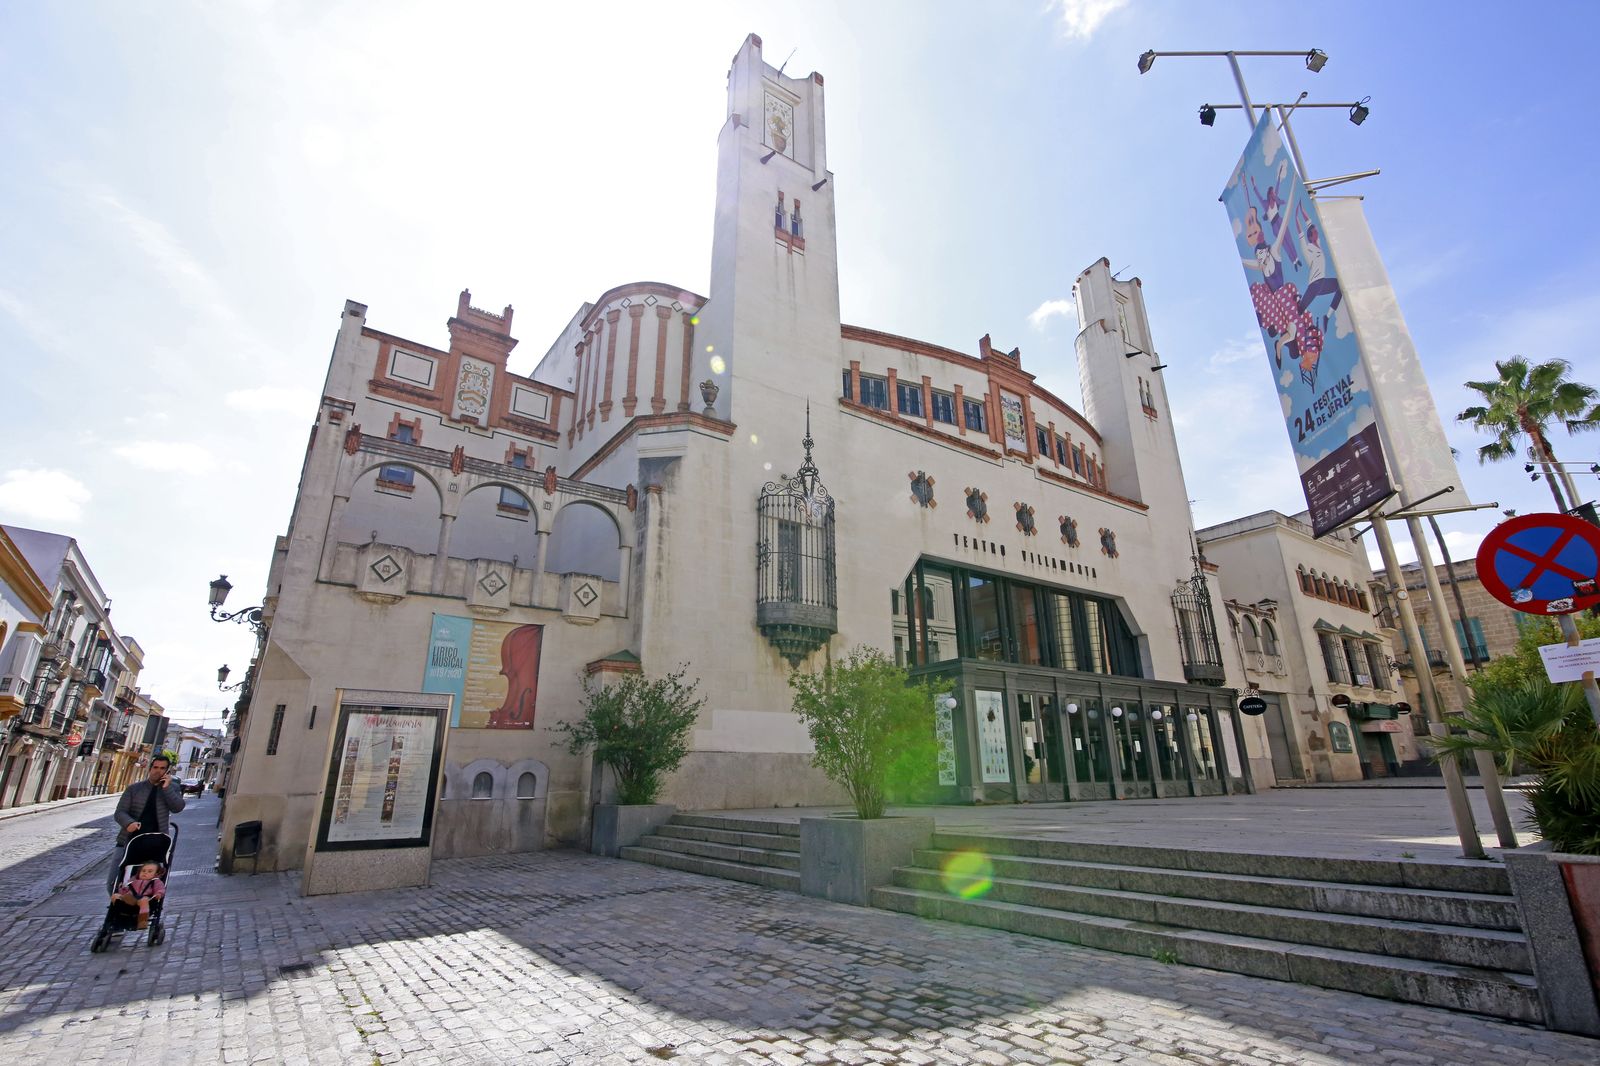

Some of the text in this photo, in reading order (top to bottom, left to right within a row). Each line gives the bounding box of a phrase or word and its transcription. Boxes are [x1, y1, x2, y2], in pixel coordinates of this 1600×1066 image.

[1294, 407, 1315, 443] 24
[1312, 374, 1354, 414] FESTIVAL
[1316, 413, 1327, 427] DE
[1327, 388, 1354, 418] JEREZ
[953, 533, 1097, 578] TEATRO VILLAMARTA
[431, 656, 464, 669] MUSICAL
